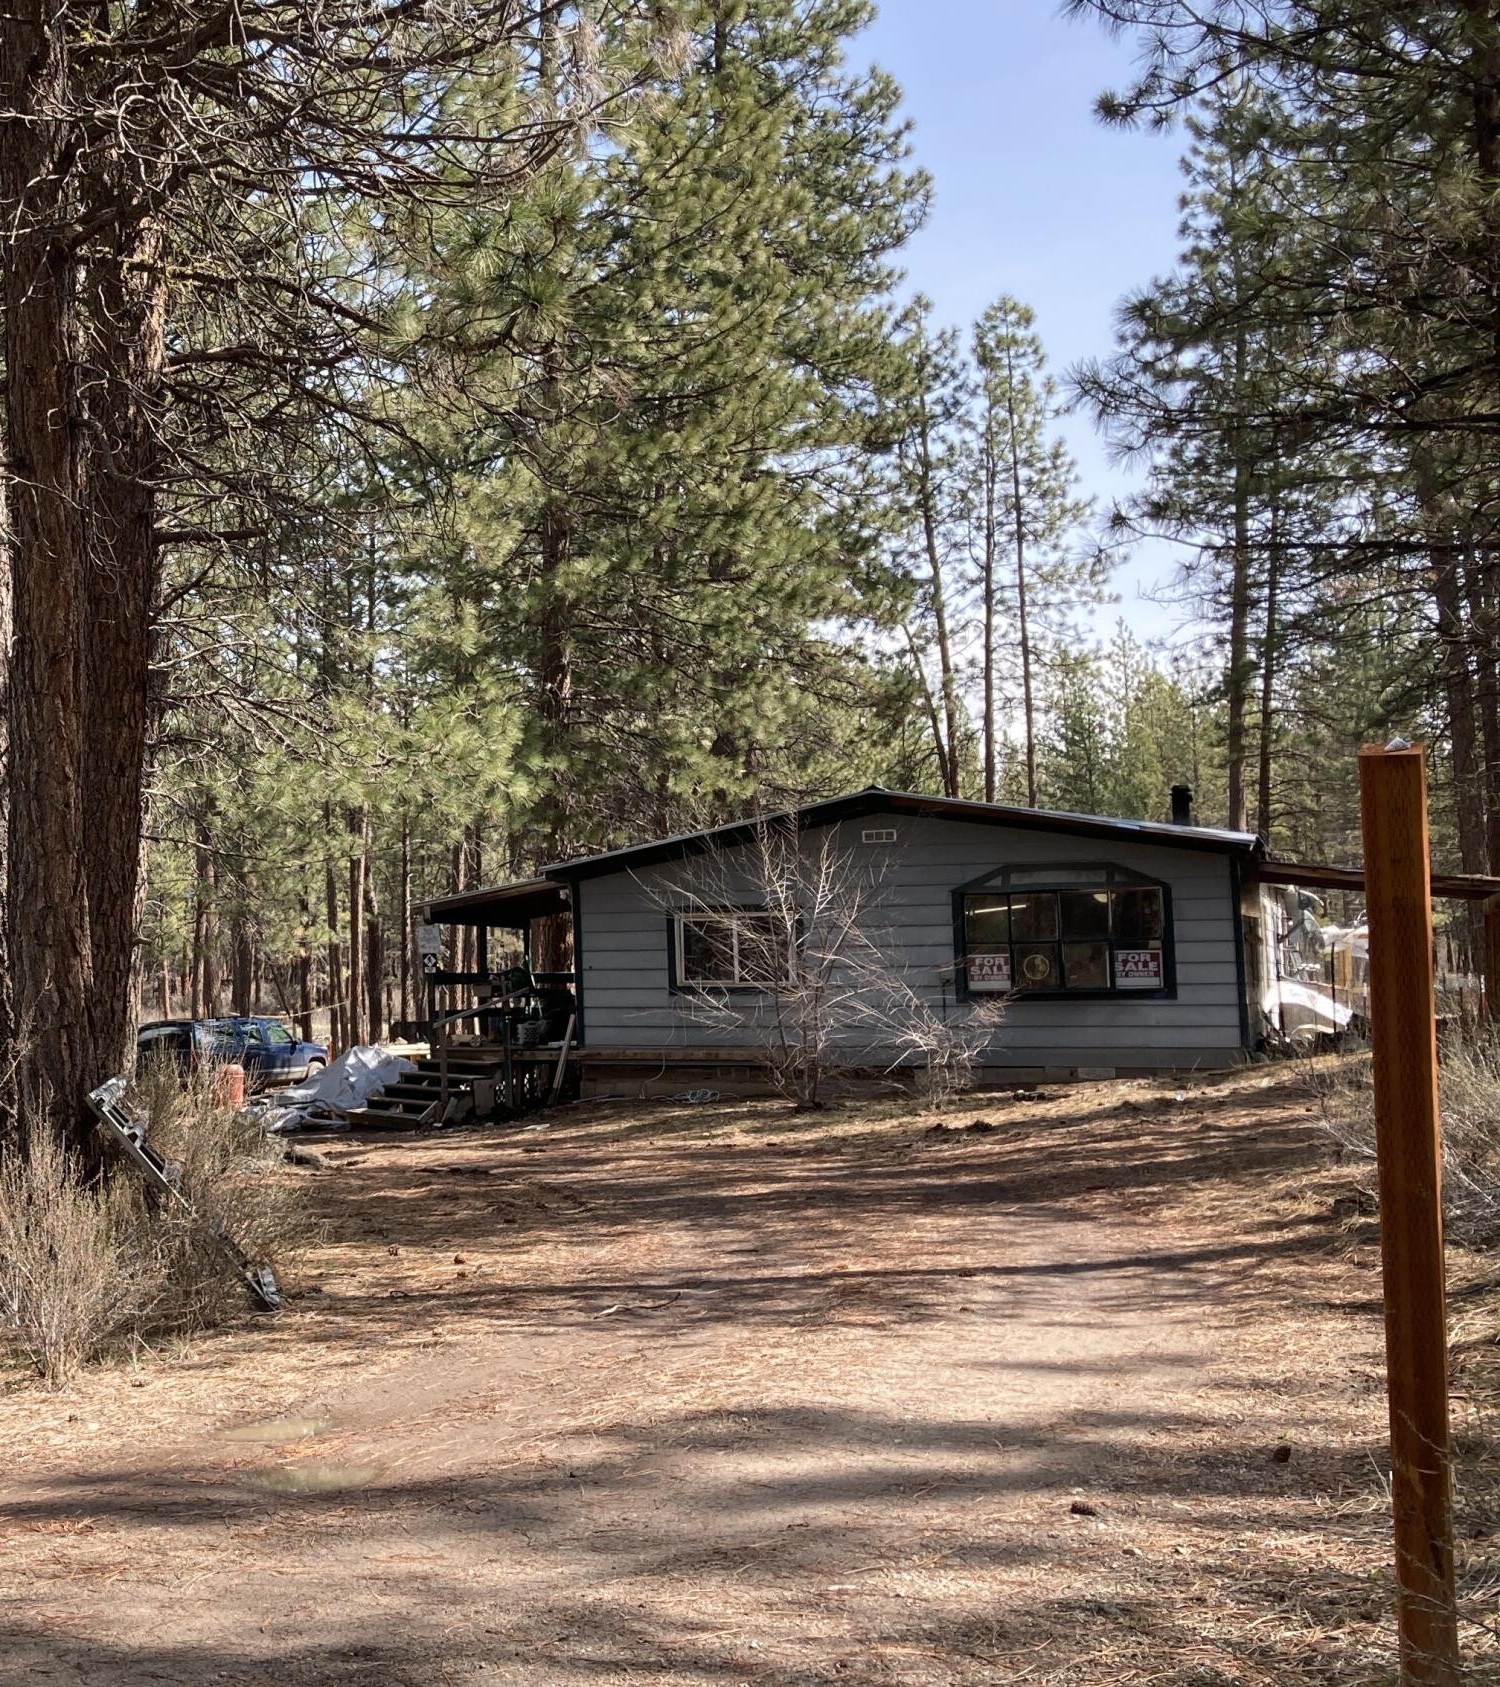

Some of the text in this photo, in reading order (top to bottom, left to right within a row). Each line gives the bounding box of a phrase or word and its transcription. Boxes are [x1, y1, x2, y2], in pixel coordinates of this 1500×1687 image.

[975, 957, 1005, 966] FOR
[1117, 953, 1152, 962] FOR
[970, 966, 1010, 975] SALE
[1114, 961, 1159, 971] SALE
